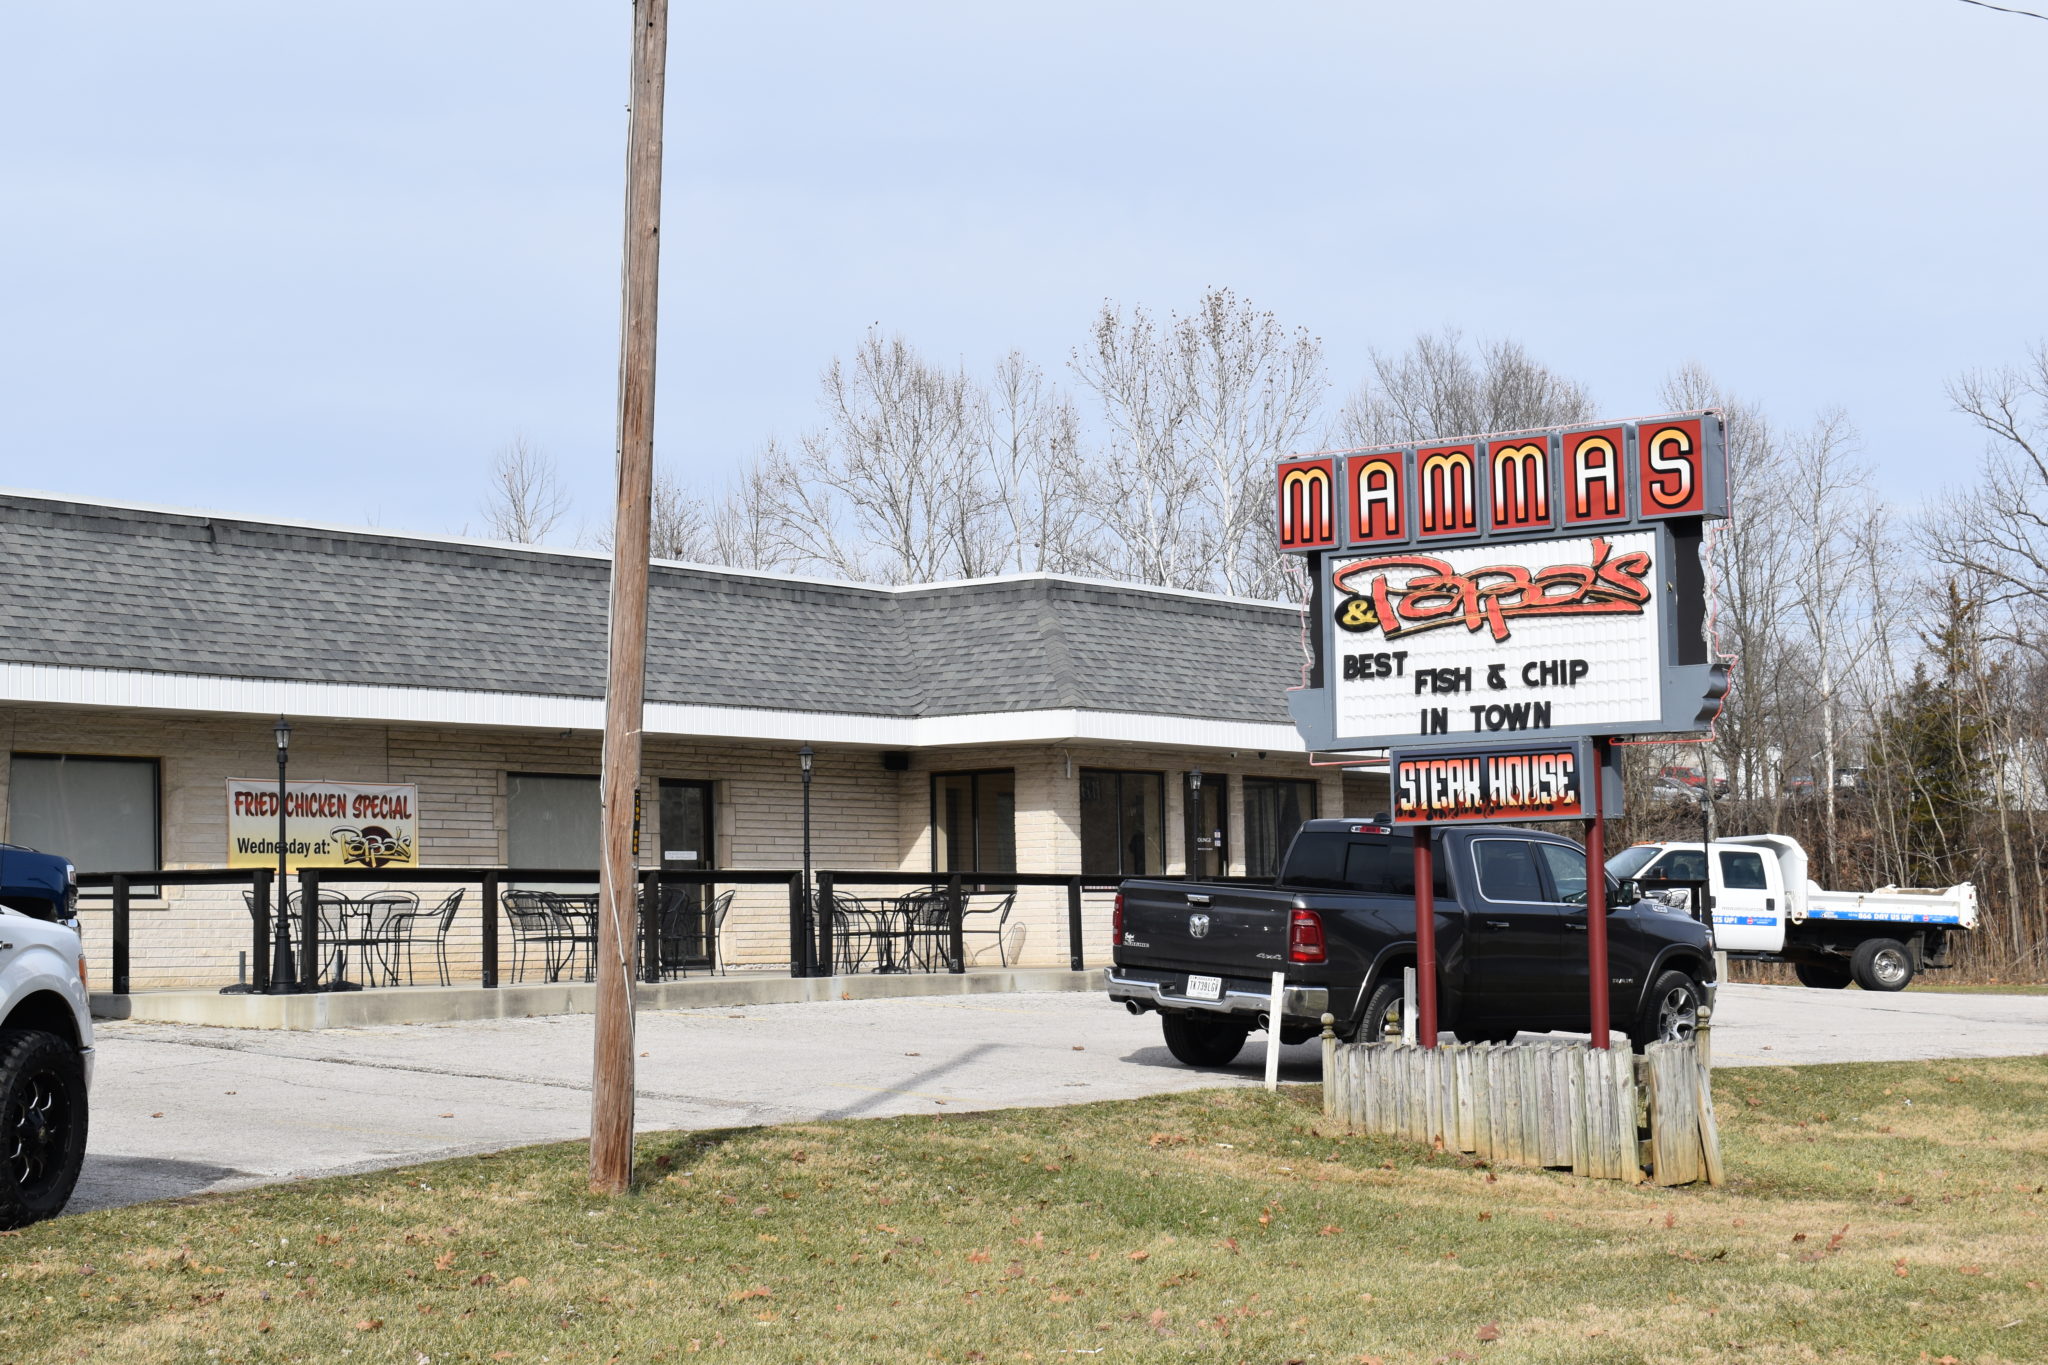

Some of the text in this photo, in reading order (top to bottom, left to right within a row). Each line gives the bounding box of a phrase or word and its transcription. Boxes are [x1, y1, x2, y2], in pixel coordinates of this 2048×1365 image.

[1281, 427, 1694, 544] MAMMAS
[1342, 599, 1378, 625] &
[1343, 651, 1408, 679] BEST
[1415, 660, 1589, 694] FISH & CHIP
[1420, 701, 1551, 735] IN TOWN
[1399, 752, 1576, 811] STEAK HOUSE
[234, 791, 412, 820] FRIED CHICKEN SPECIAL
[314, 841, 330, 855] at:
